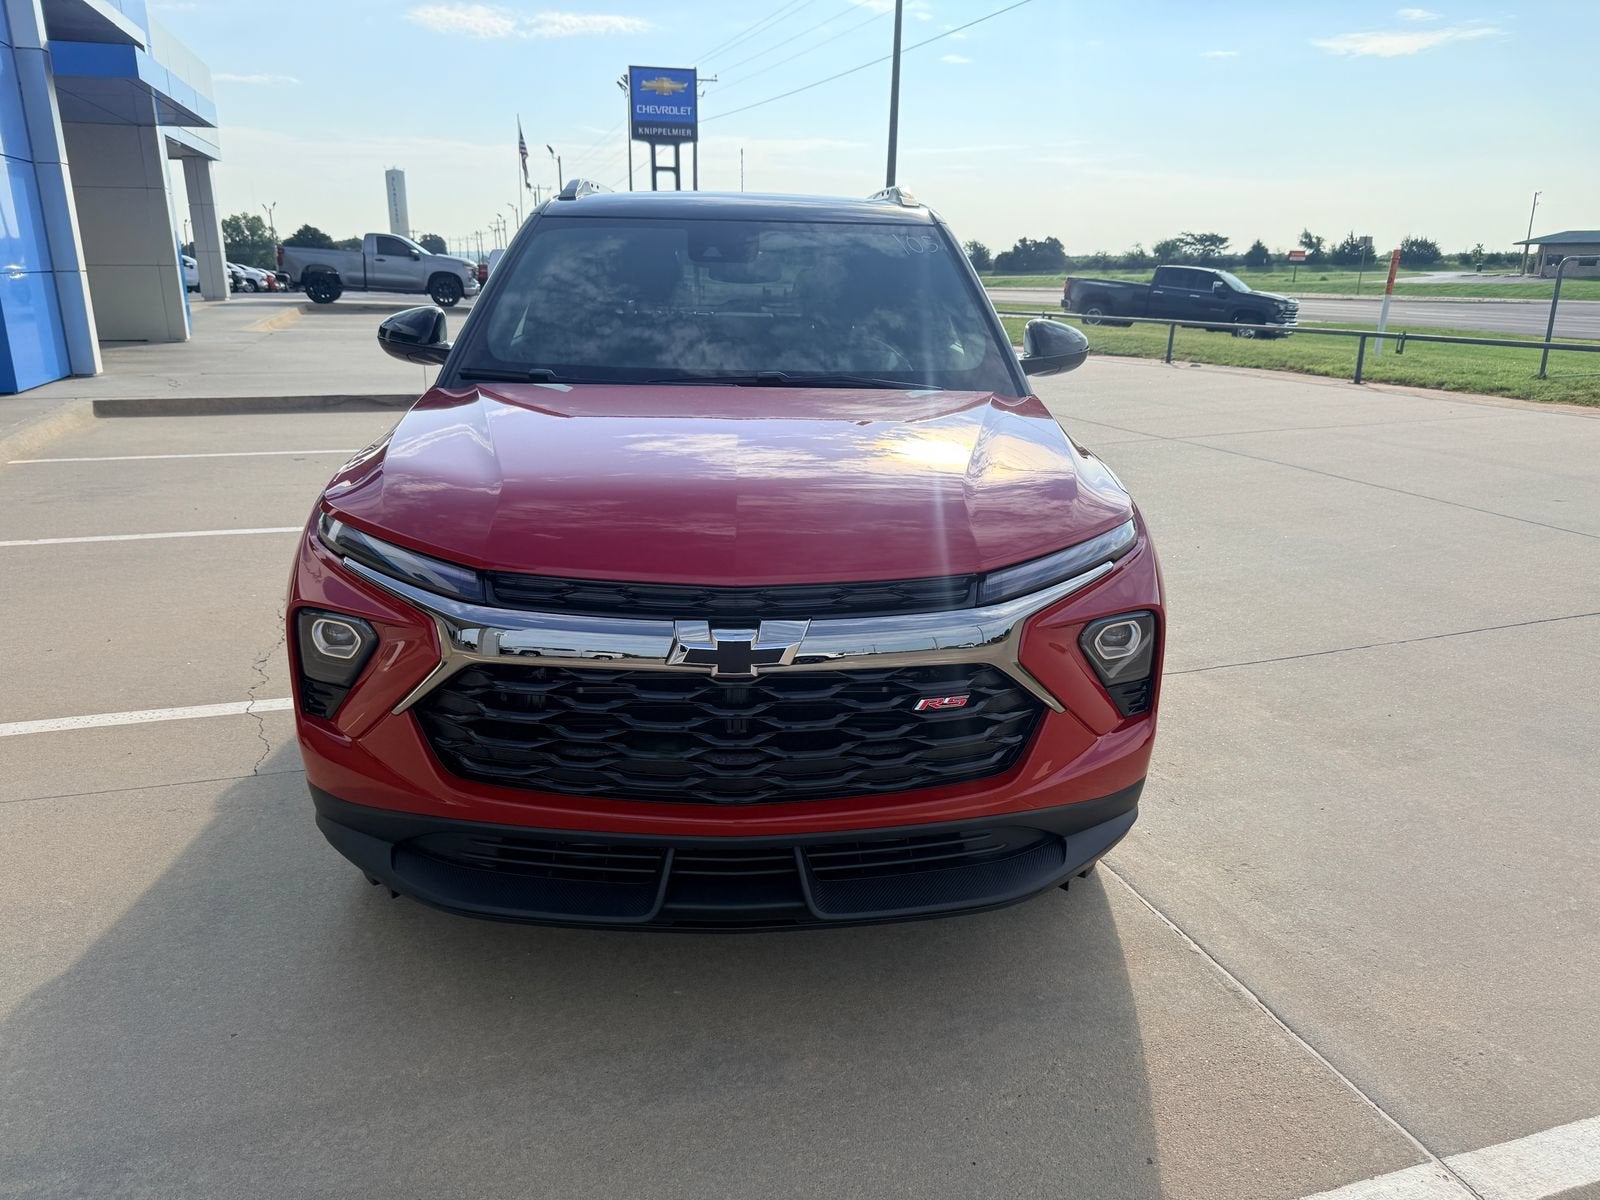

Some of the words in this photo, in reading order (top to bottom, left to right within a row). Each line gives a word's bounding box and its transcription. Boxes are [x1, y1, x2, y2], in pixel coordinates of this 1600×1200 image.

[636, 104, 692, 116] CHEVROLET
[638, 127, 692, 137] KNIPPELMIER
[914, 694, 970, 711] RS
